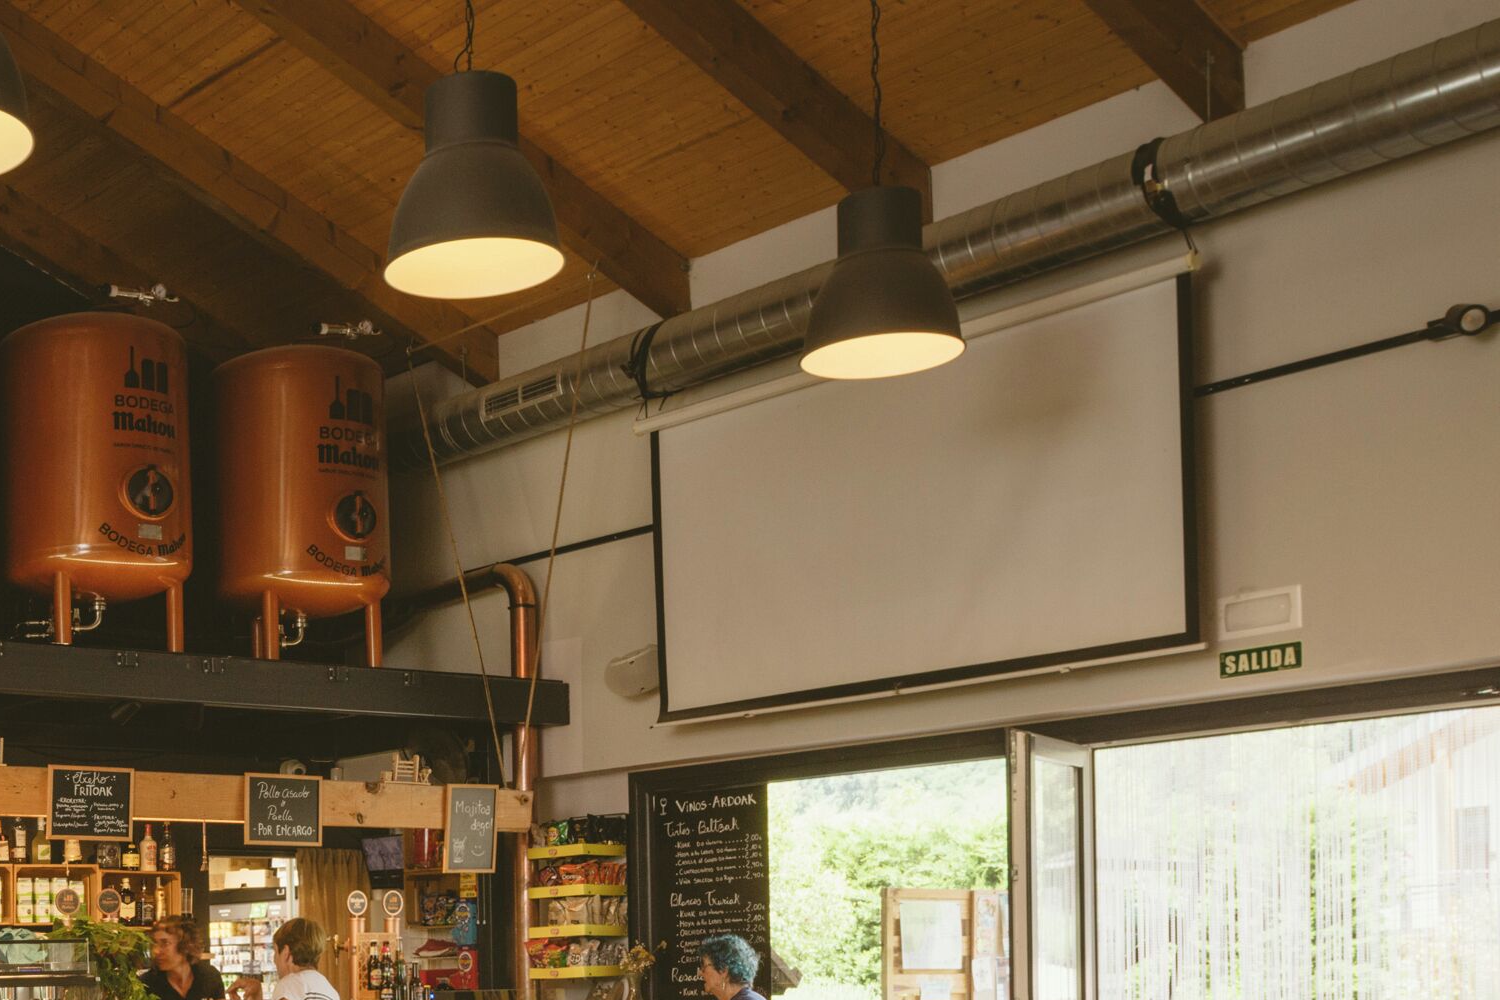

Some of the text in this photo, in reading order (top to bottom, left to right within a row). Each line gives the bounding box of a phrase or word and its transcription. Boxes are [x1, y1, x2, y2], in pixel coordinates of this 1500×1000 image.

[114, 394, 174, 414] BODEGA
[112, 411, 175, 439] Mahou
[98, 522, 153, 556] BODEGA
[306, 544, 357, 577] BODEGA
[1225, 646, 1297, 674] SALIDA
[74, 784, 113, 796] FRITOAK
[257, 781, 310, 799] Pollo asado
[268, 804, 293, 821] Paella
[455, 800, 491, 817] Mojitoa
[258, 822, 313, 837] POR ENCARGO
